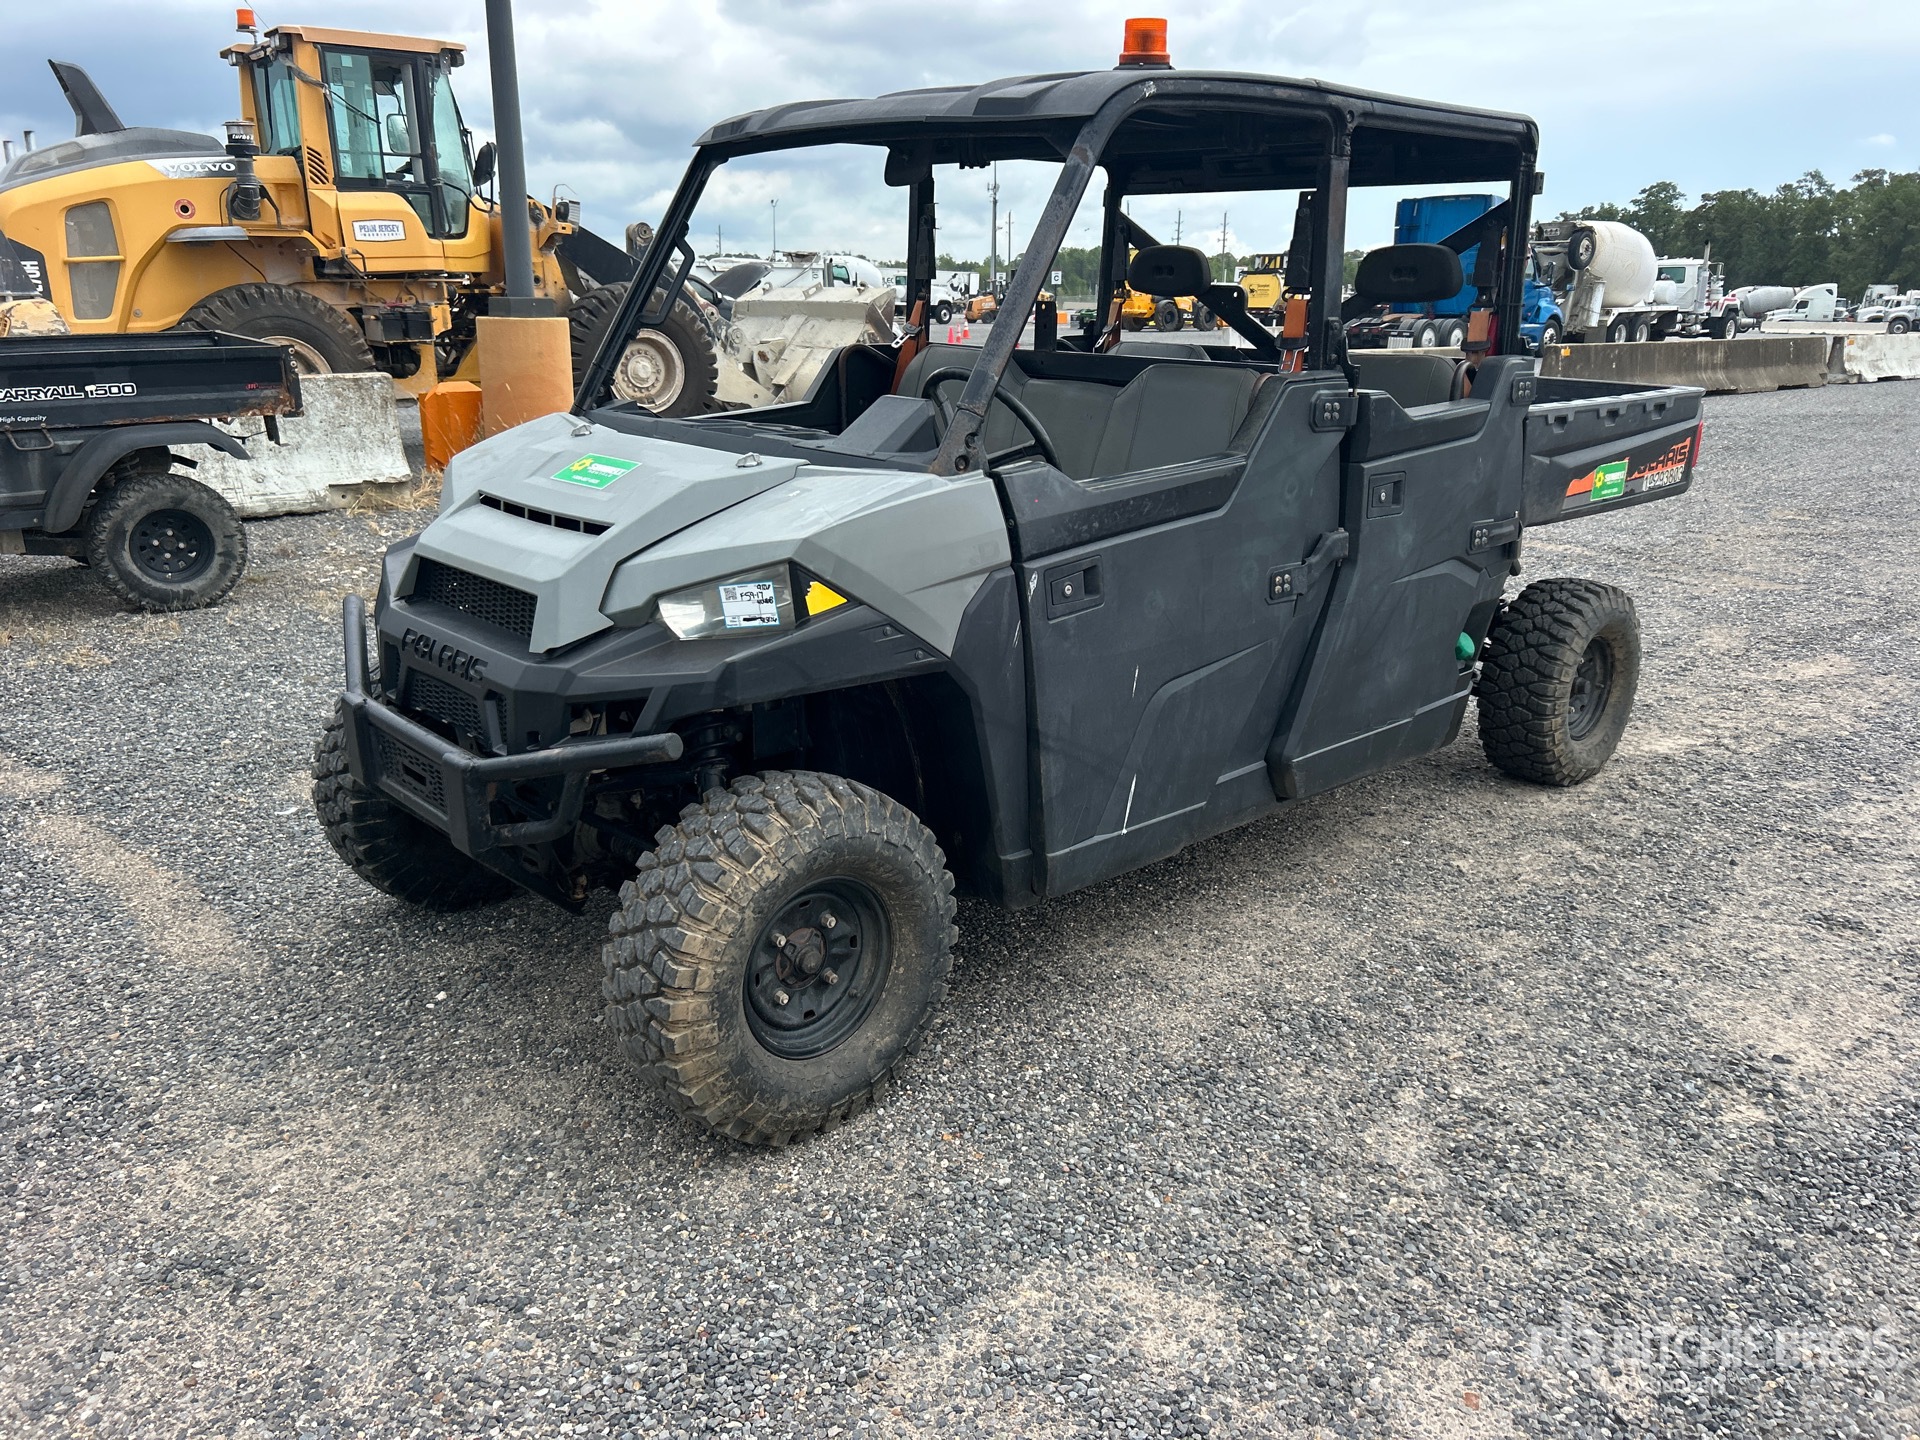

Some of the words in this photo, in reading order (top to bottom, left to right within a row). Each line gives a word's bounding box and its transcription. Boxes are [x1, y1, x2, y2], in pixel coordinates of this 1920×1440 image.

[163, 162, 236, 172] VOLVO
[359, 224, 377, 233] PENN
[378, 224, 400, 233] JERSEY
[1053, 274, 1060, 282] C
[0, 385, 85, 403] ARRYALL
[85, 383, 137, 398] 1500
[0, 416, 16, 424] High
[17, 415, 47, 423] Capacity
[401, 627, 489, 682] POLARIS
